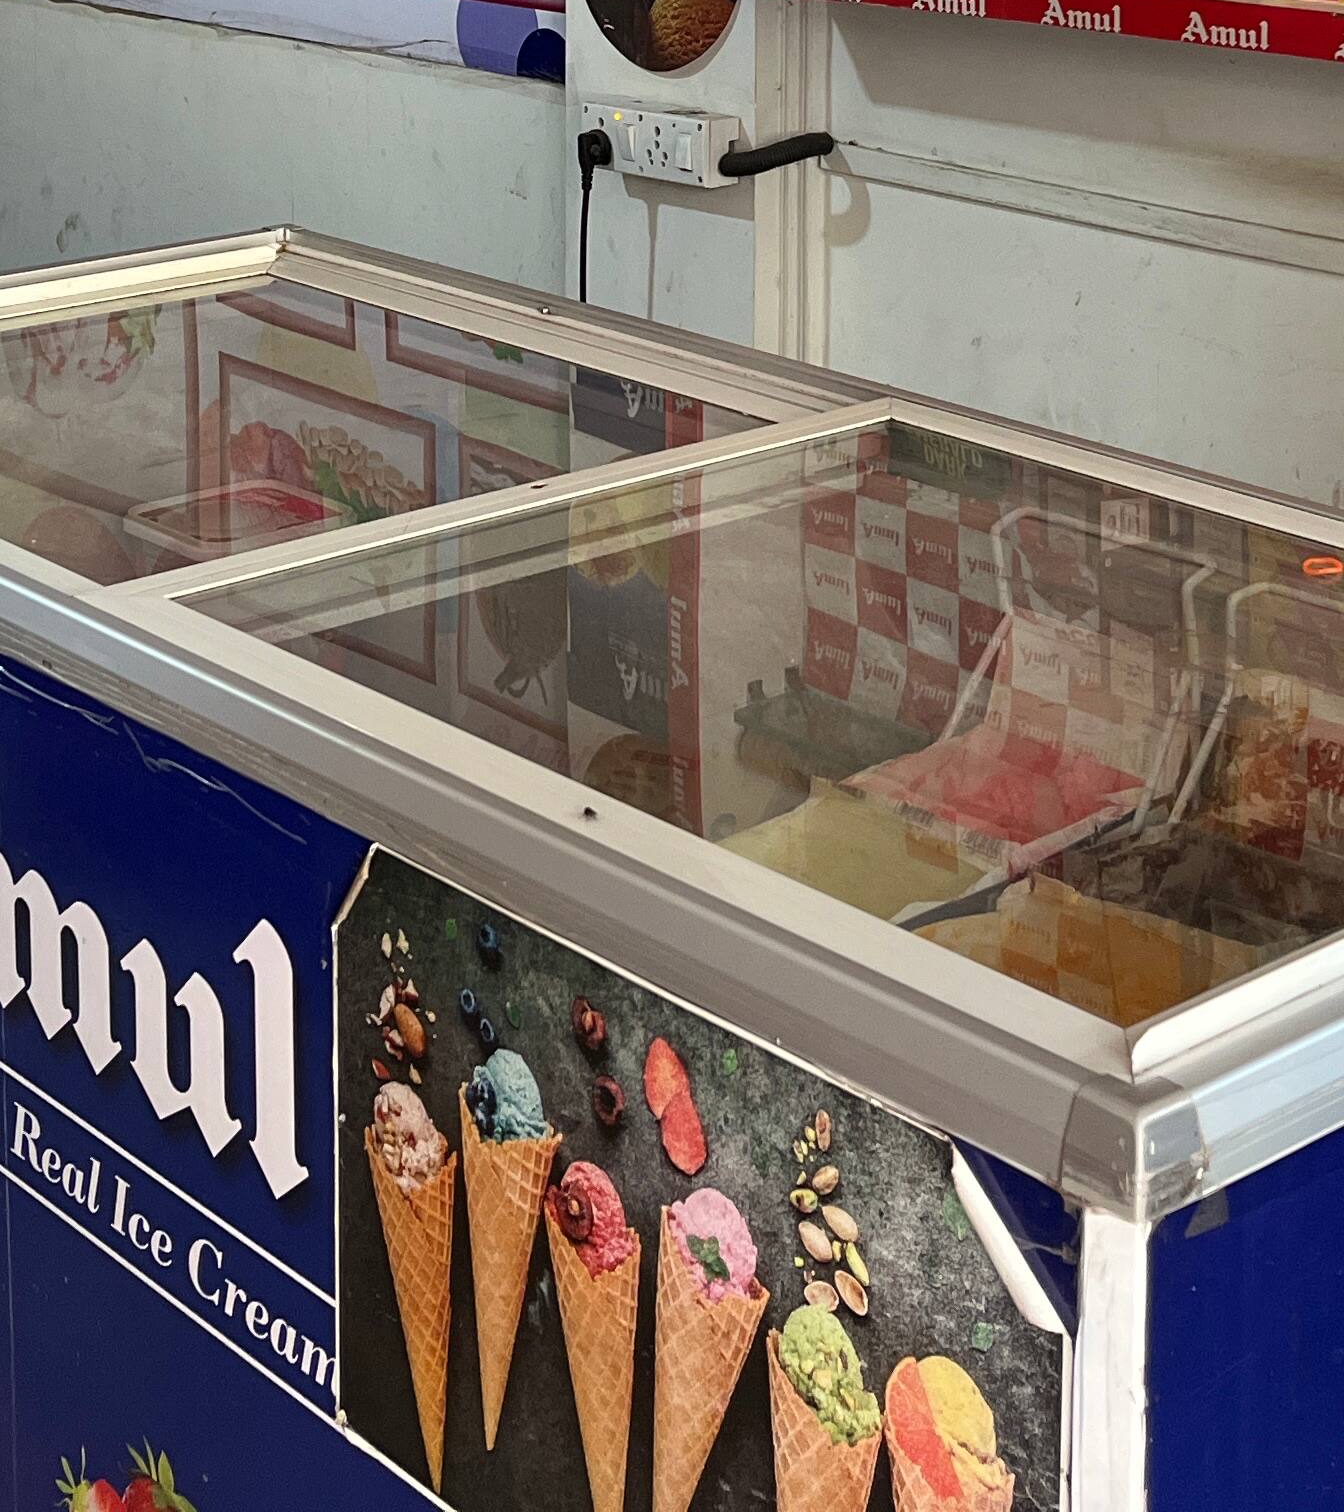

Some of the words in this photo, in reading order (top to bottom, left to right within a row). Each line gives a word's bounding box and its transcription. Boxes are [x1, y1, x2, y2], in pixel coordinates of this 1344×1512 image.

[11, 1101, 100, 1215] Real
[110, 1173, 174, 1268] Ice
[188, 1238, 340, 1390] Cream
